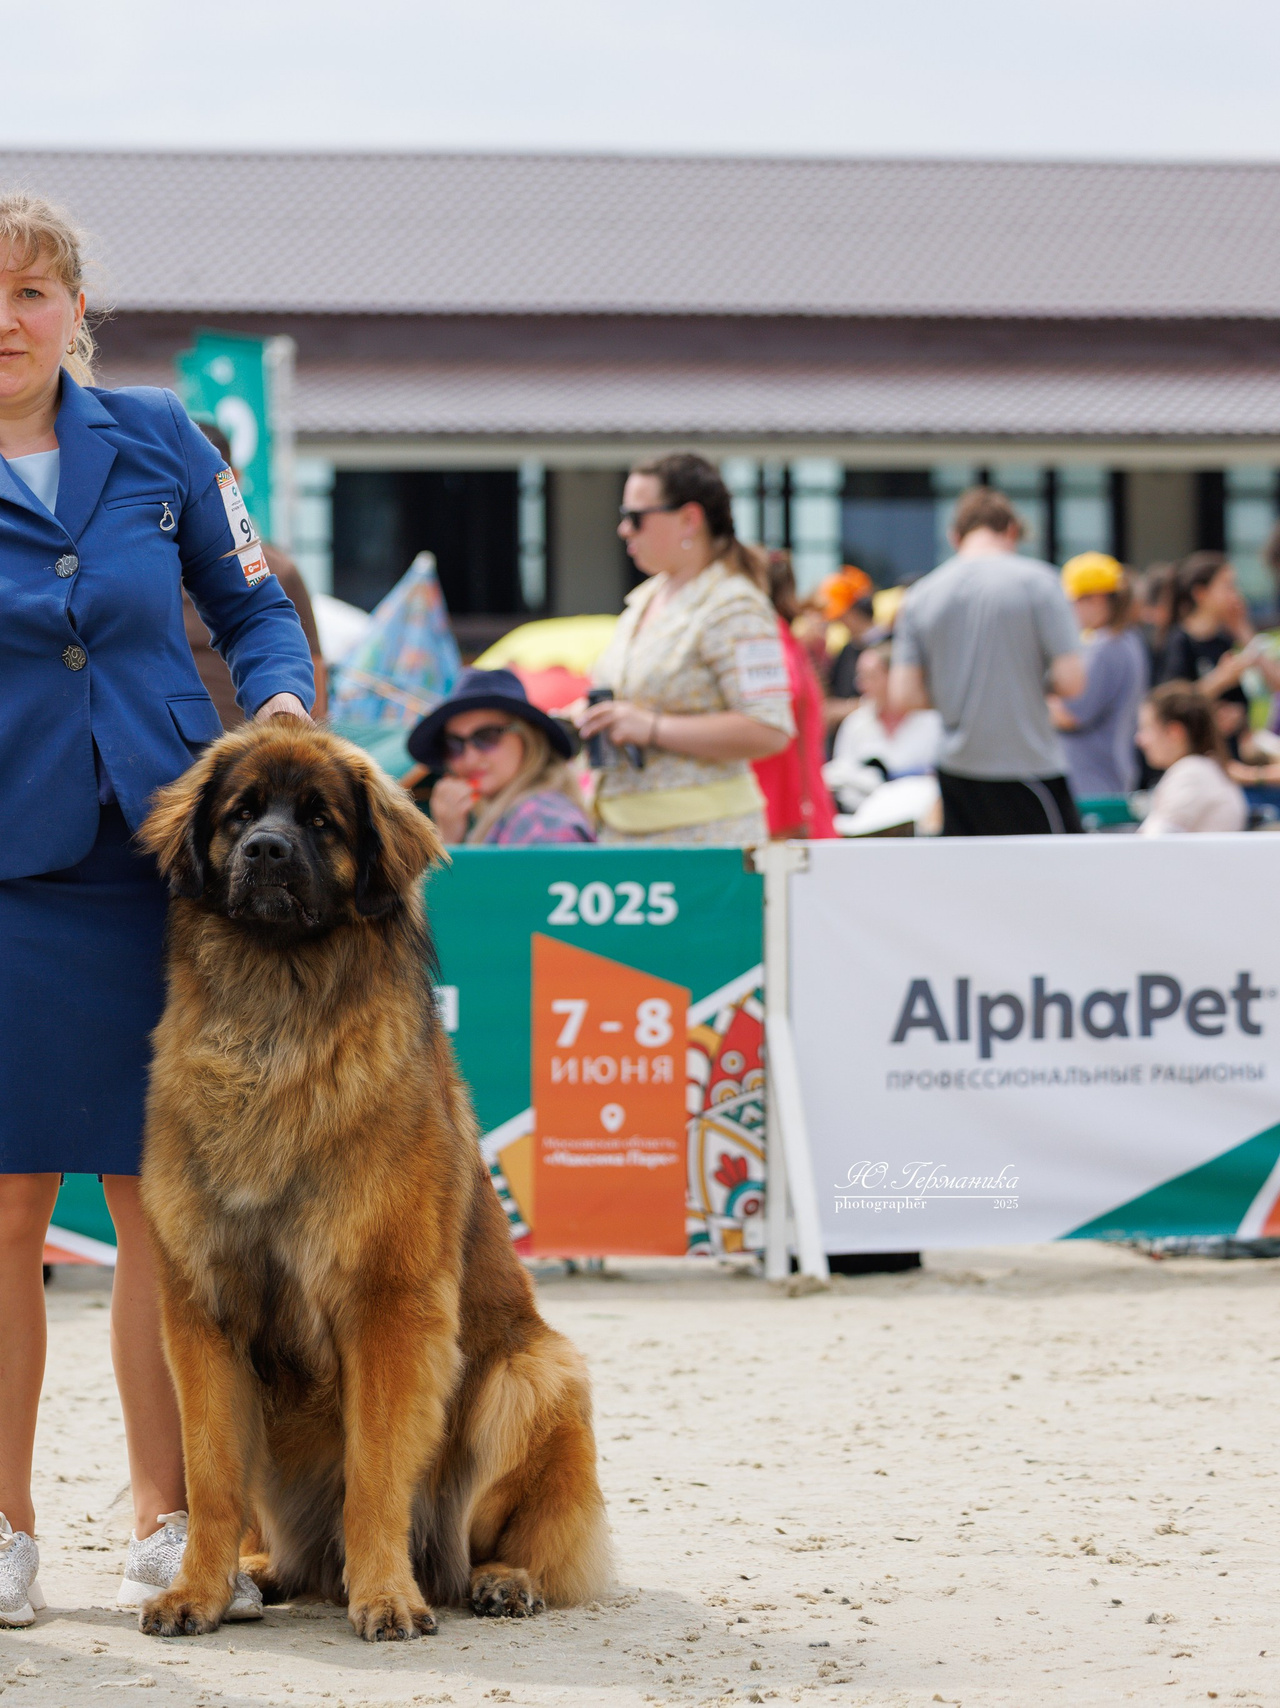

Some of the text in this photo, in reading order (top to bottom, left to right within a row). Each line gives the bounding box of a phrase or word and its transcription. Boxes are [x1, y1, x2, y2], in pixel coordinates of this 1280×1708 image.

[547, 880, 679, 926] 2025
[551, 999, 589, 1049] 7
[634, 997, 674, 1049] 8
[550, 1055, 674, 1085] ИЮНЯ
[886, 1062, 1266, 1091] ПРОФЕССИОНАЛЬНЫЕ РАЦИОНЫ
